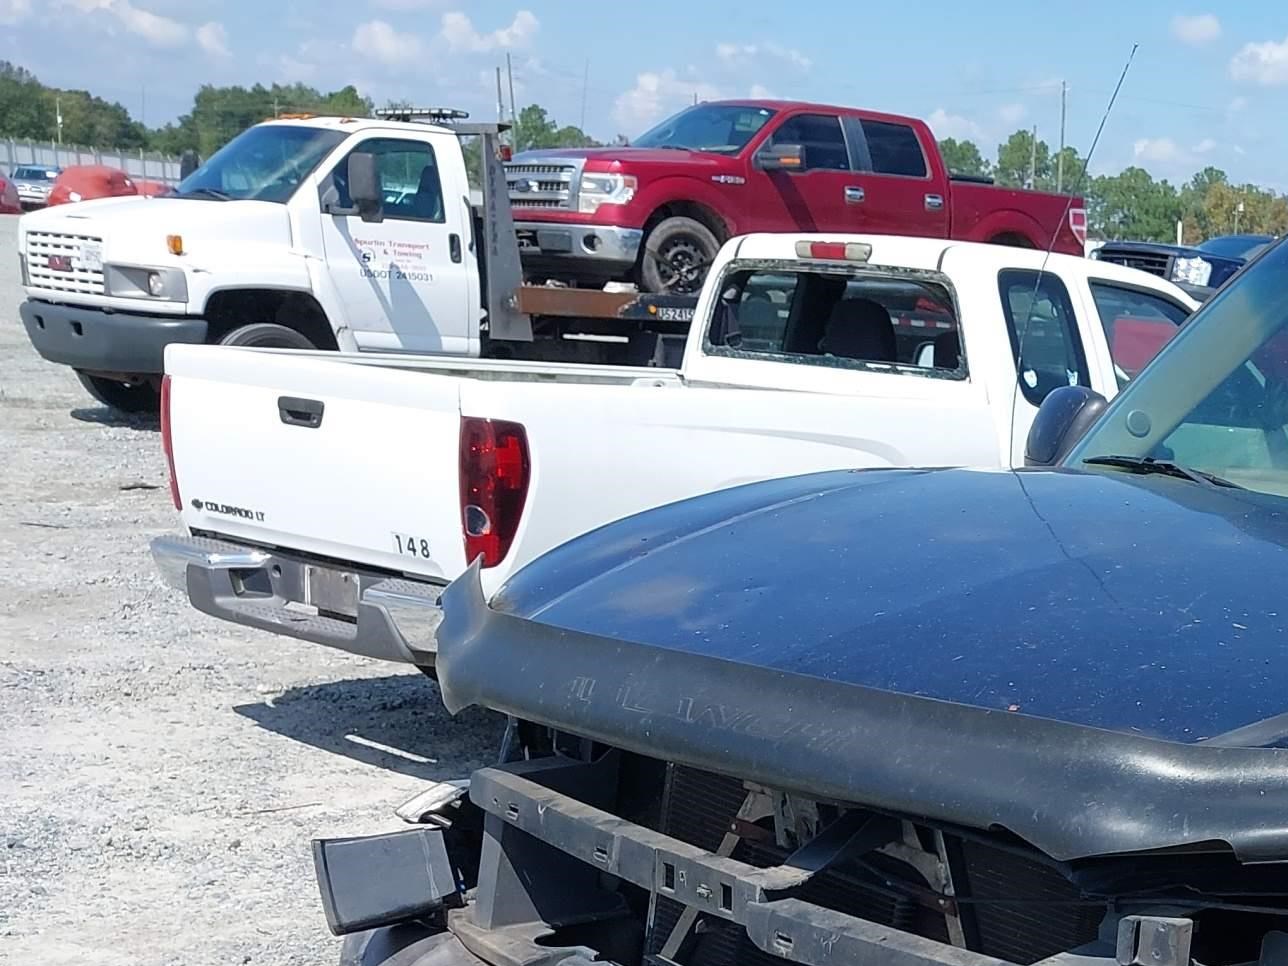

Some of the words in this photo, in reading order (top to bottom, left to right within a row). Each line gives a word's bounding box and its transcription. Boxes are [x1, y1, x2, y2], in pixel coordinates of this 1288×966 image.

[205, 501, 254, 520] COLORADO
[255, 511, 265, 522] LT
[395, 534, 430, 559] 148
